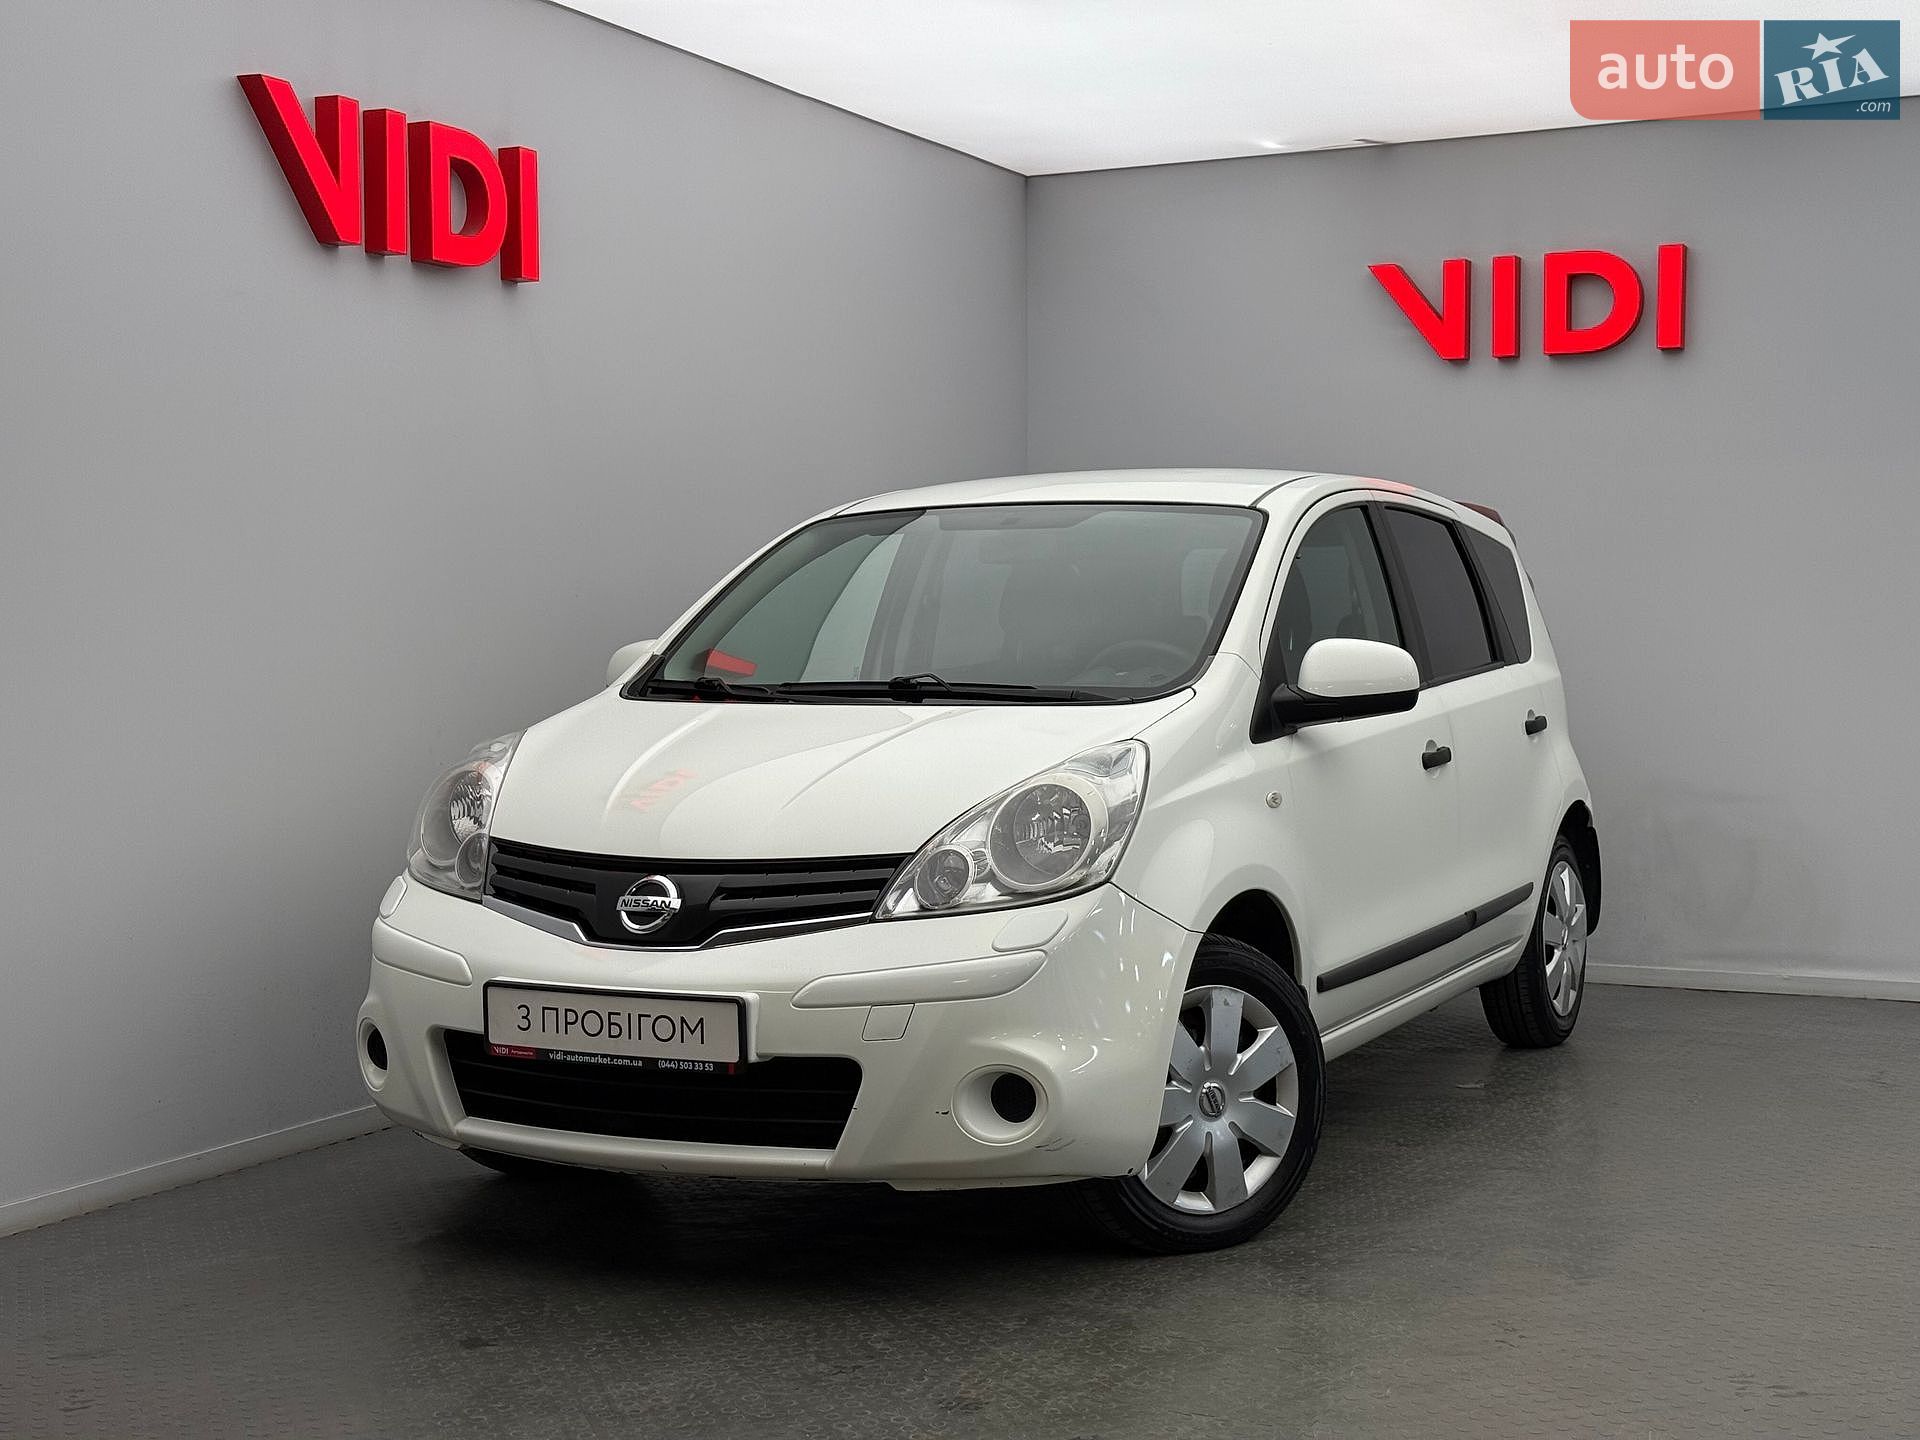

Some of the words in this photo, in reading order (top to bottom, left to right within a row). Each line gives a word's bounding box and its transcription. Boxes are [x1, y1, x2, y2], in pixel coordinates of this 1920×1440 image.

[237, 73, 540, 283] VIDI
[1367, 243, 1688, 362] VIDI
[620, 898, 672, 908] NISSAN
[541, 1005, 705, 1045] ПРОБІГОМ
[494, 1046, 509, 1055] VIDI
[548, 1051, 643, 1067] vidi-automarket.com.ua
[658, 1059, 678, 1070] (044)
[679, 1061, 693, 1070] 503
[694, 1062, 703, 1070] 33
[704, 1062, 714, 1071] 53
